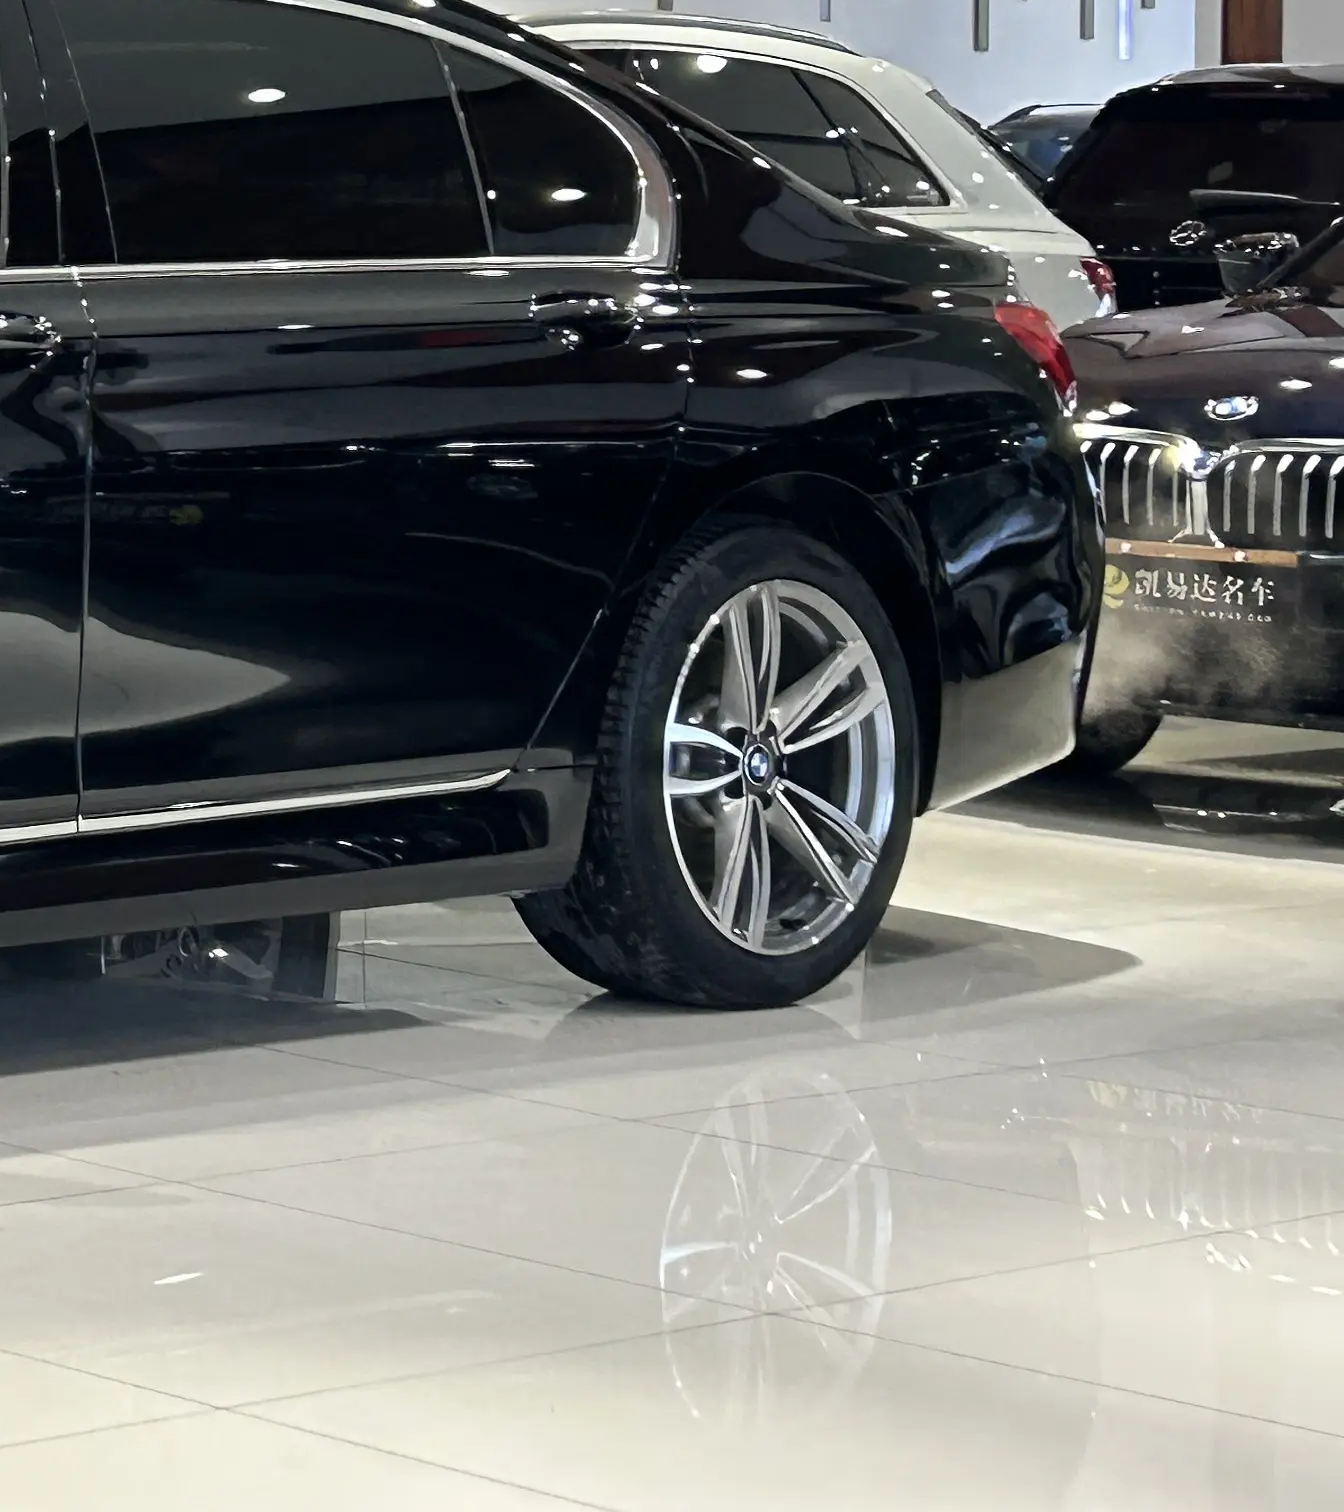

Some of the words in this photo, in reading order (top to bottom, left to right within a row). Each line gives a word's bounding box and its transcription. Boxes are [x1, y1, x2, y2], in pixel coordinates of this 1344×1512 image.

[1134, 568, 1275, 607] 凯易达名车
